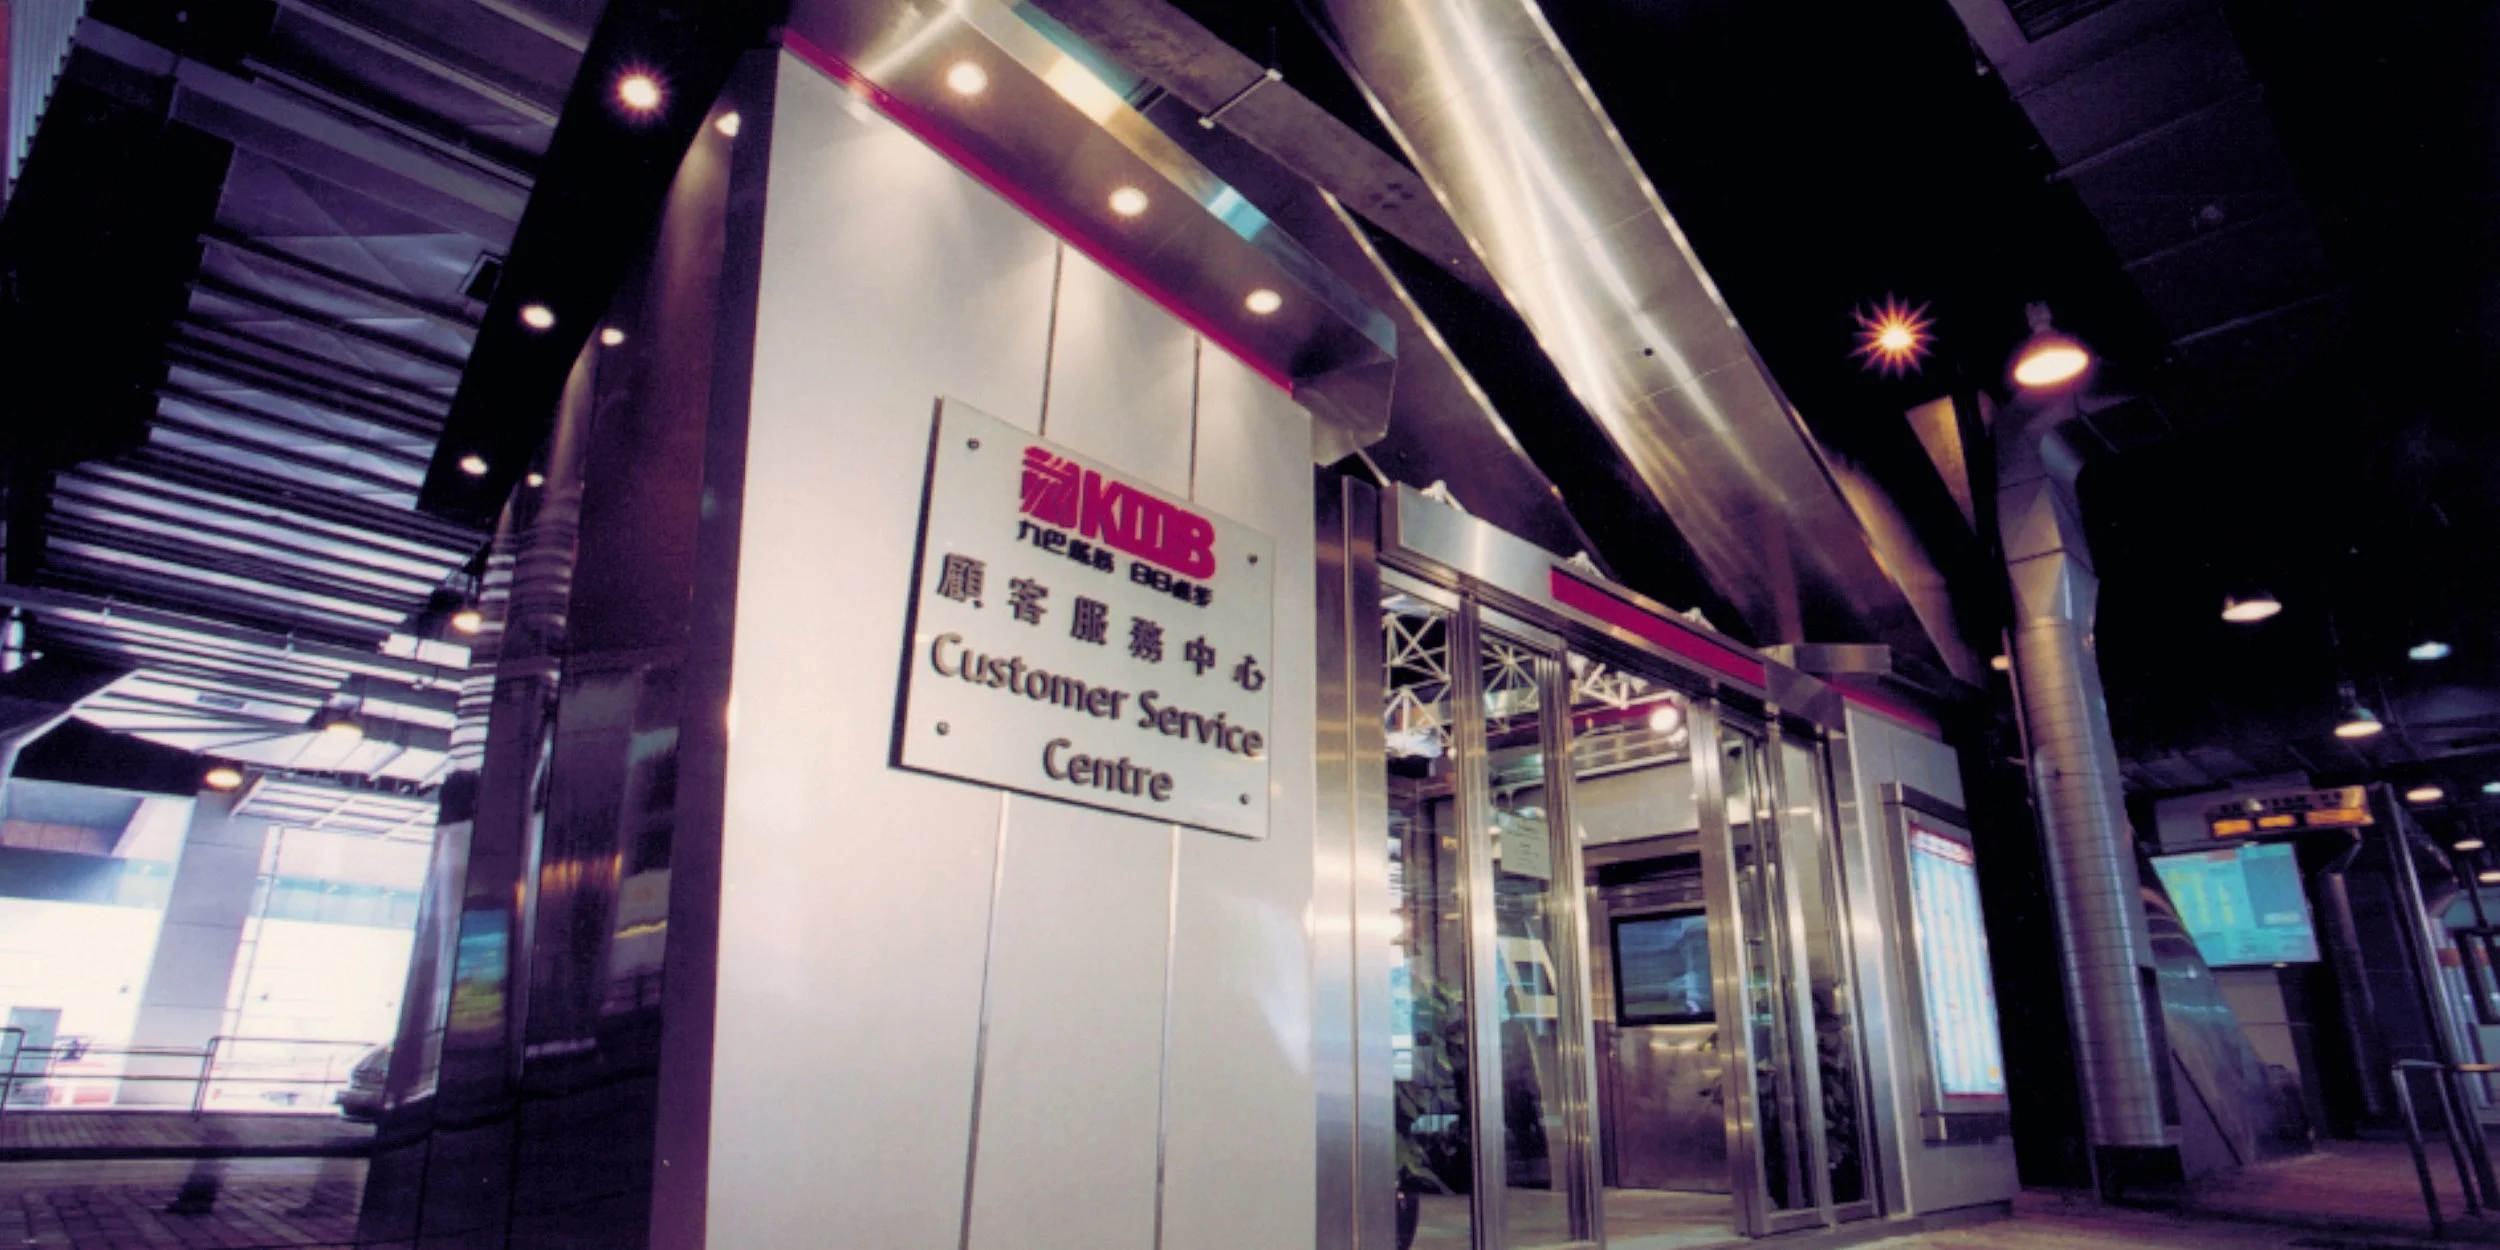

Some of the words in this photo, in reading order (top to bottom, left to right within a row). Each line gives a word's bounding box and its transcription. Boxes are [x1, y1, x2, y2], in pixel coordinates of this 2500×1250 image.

[1079, 469, 1216, 581] KMB
[937, 552, 1266, 692] 顧客服務中心
[930, 632, 1130, 720] Customer
[1137, 690, 1264, 757] Service
[1042, 738, 1174, 802] Centre
